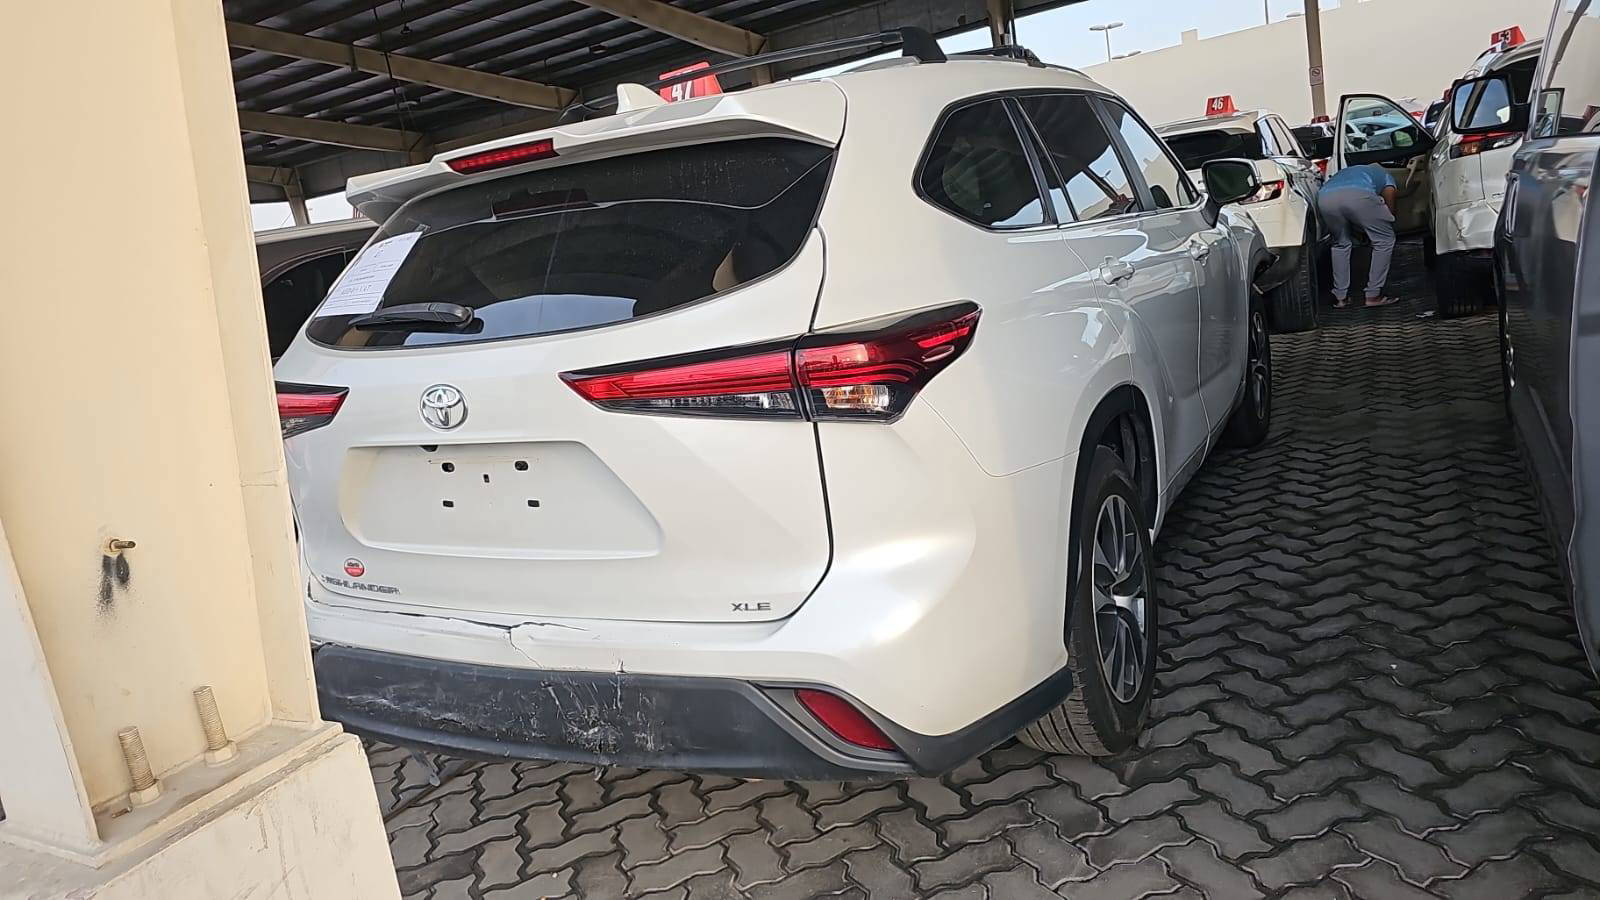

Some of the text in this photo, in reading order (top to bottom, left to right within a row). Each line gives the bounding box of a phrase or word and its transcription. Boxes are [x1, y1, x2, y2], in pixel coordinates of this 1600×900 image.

[671, 72, 693, 102] 47
[1211, 97, 1224, 111] 46
[731, 602, 771, 612] XLE
